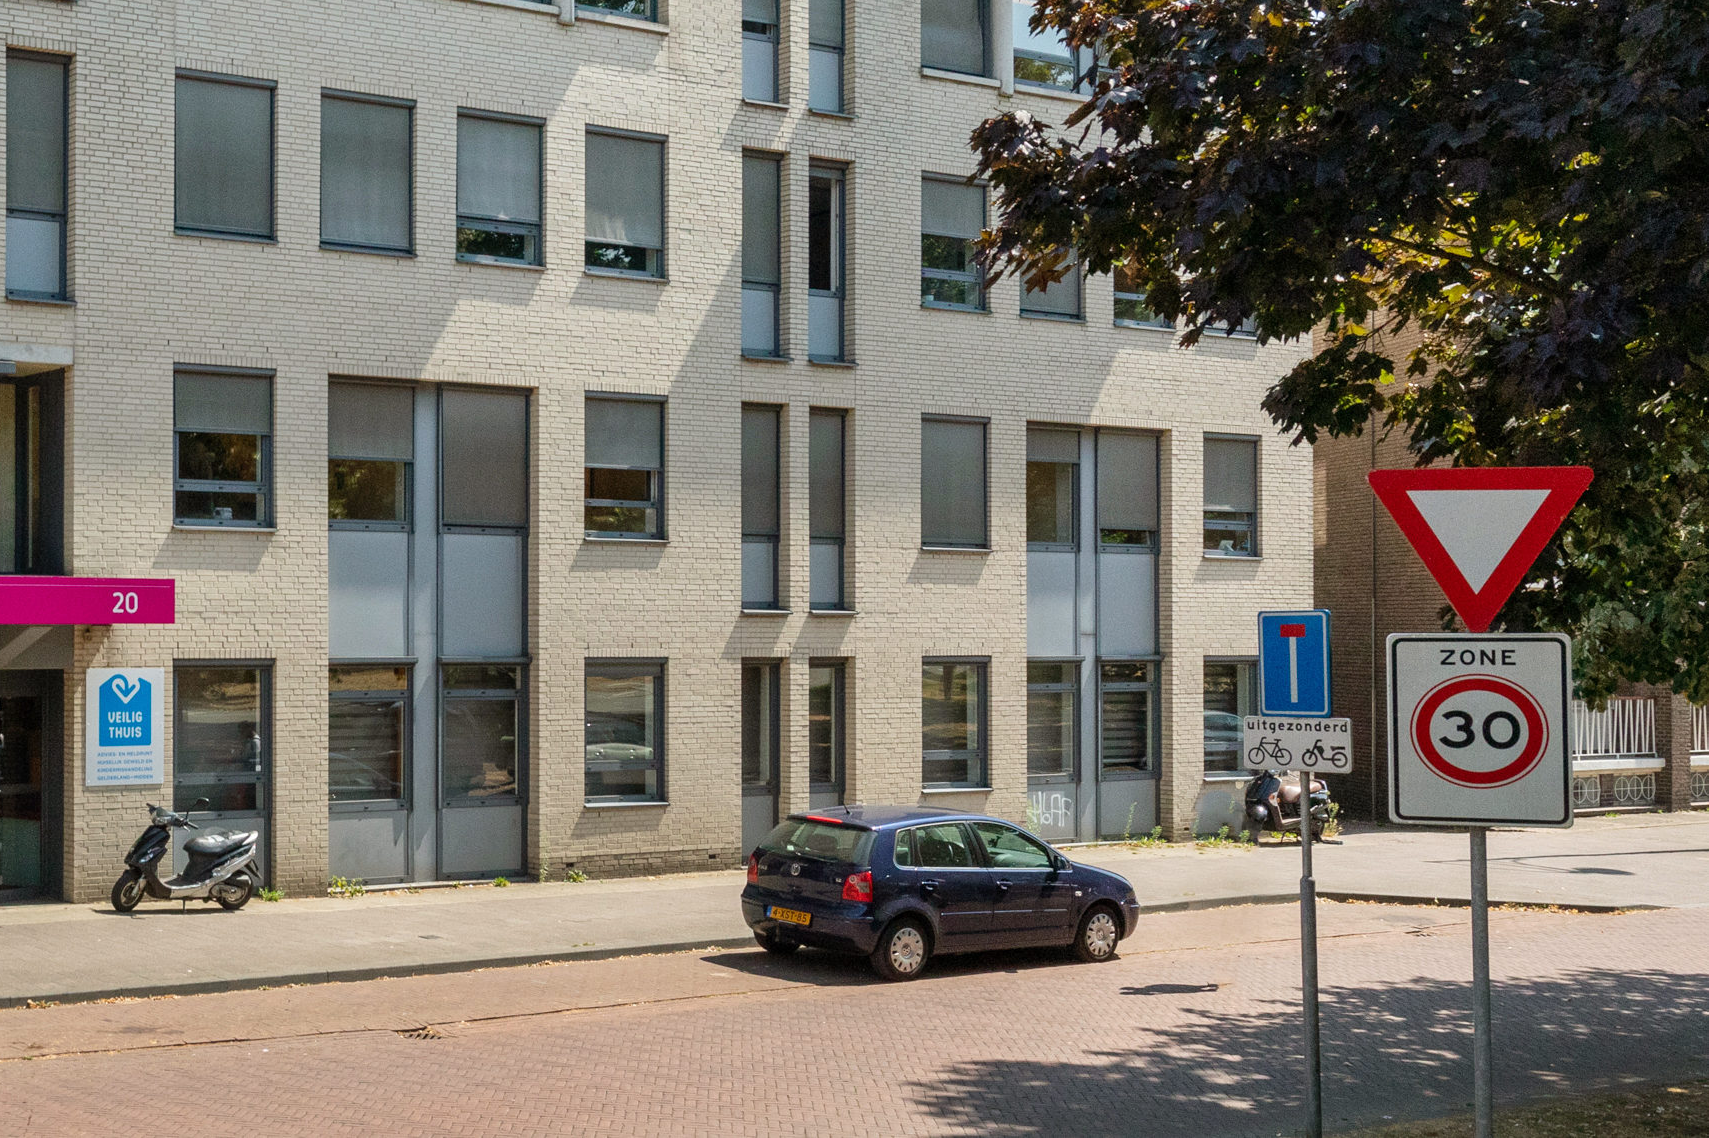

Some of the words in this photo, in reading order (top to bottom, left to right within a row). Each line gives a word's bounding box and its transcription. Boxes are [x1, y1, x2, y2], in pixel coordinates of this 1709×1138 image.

[112, 591, 139, 614] 20
[1439, 649, 1517, 666] ZONE
[107, 710, 143, 723] VEILIG
[108, 726, 143, 739] THUIS
[1247, 719, 1348, 734] uitgezonderd
[1439, 710, 1521, 750] 30
